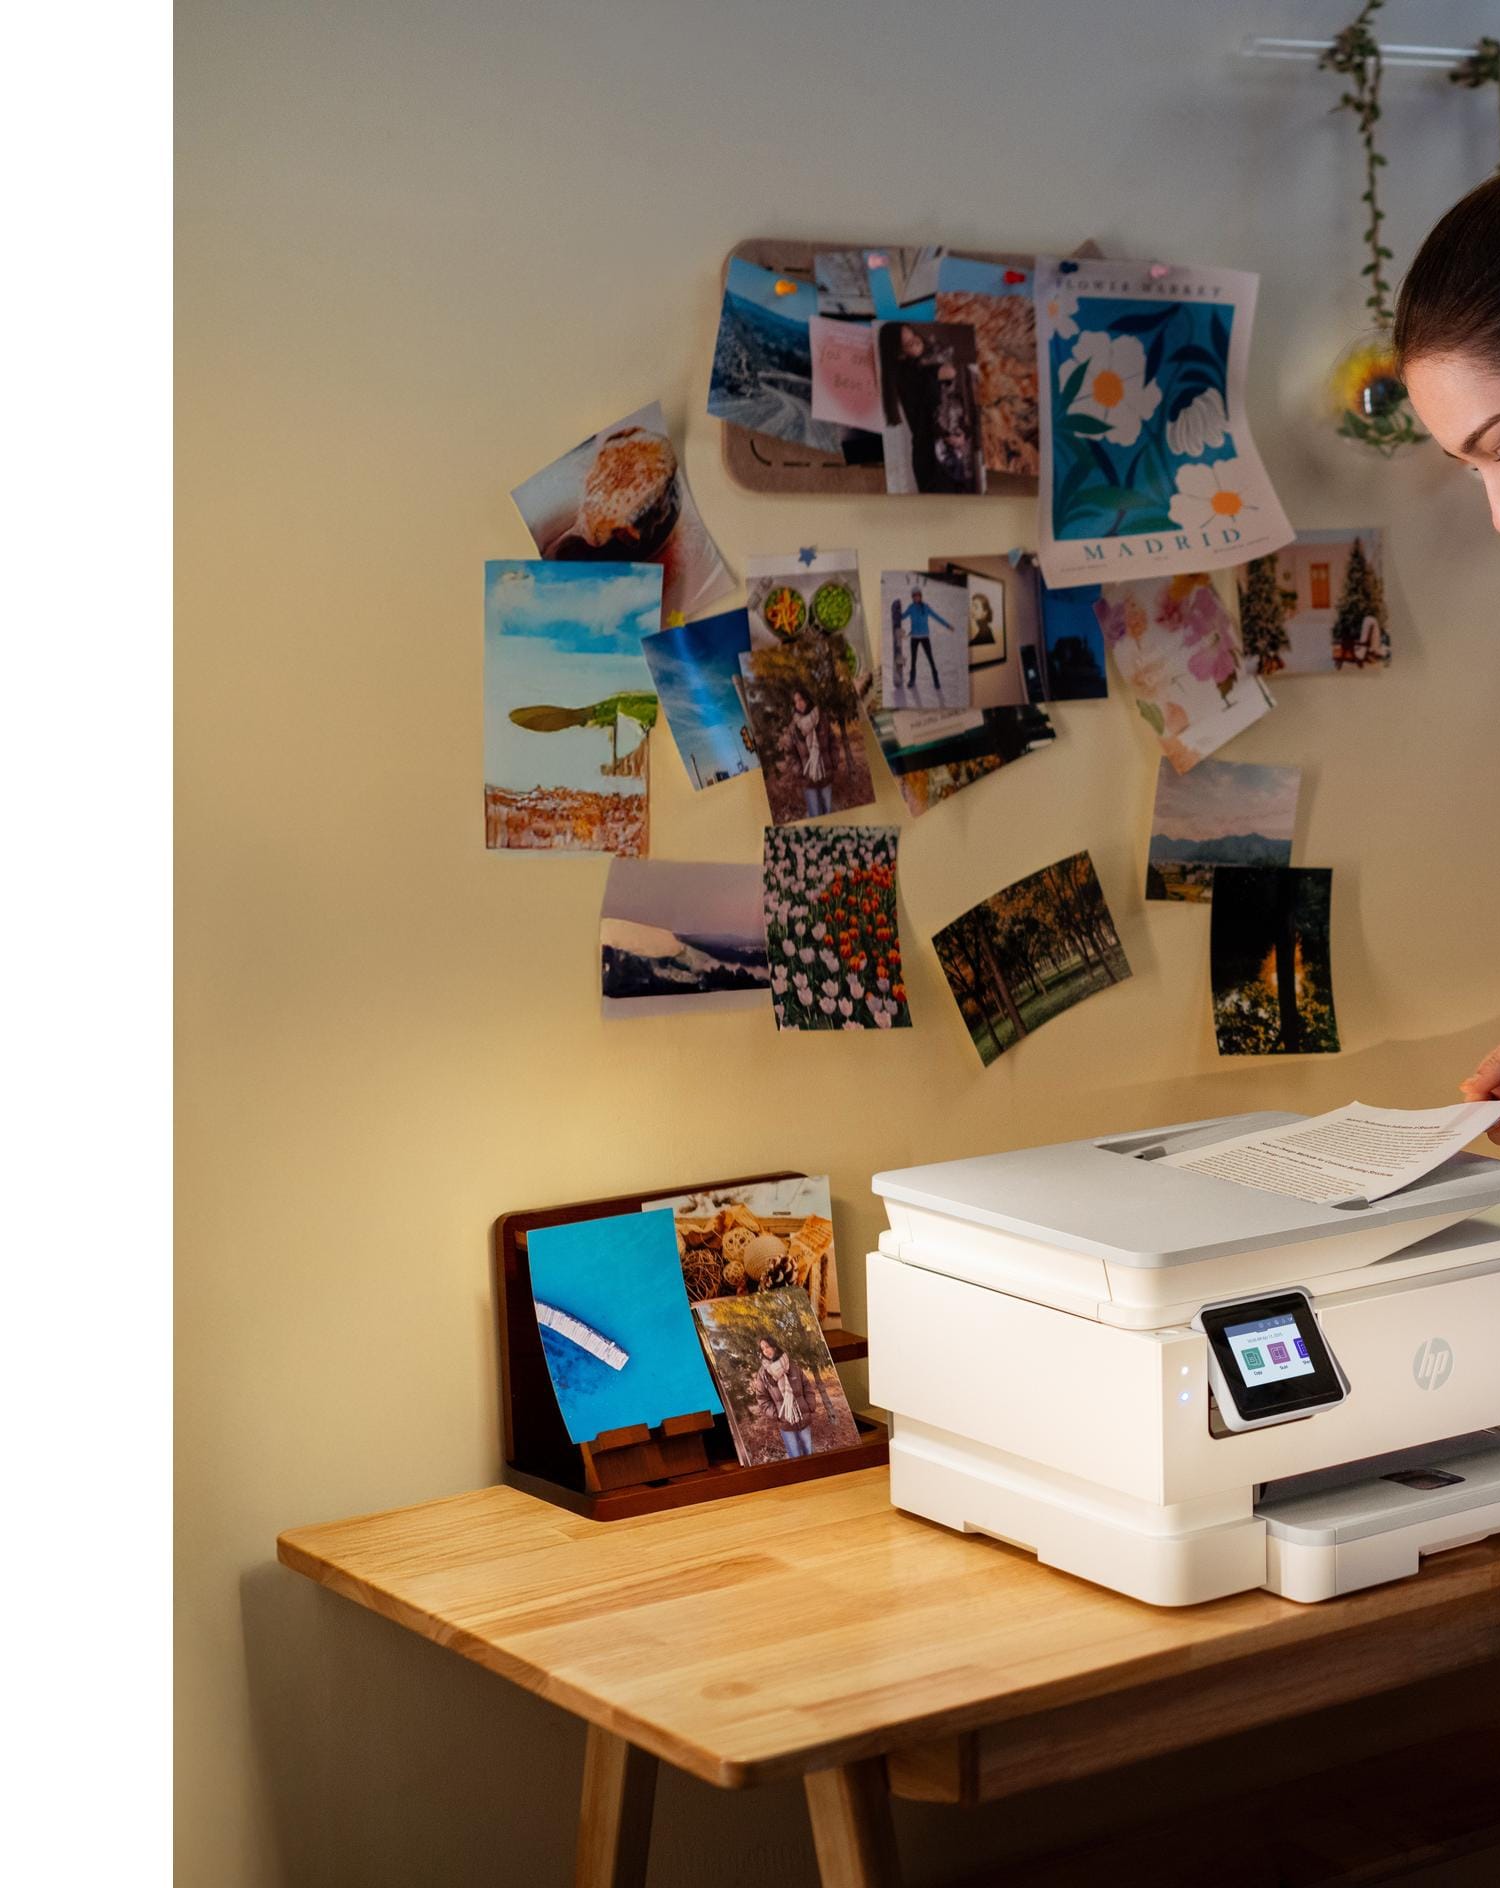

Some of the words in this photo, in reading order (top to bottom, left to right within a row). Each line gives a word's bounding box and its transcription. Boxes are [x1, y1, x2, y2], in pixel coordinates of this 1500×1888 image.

[1055, 276, 1130, 292] FLOWER
[1141, 281, 1222, 297] MARKET
[1083, 528, 1241, 560] MADRID
[1416, 1338, 1450, 1391] hp
